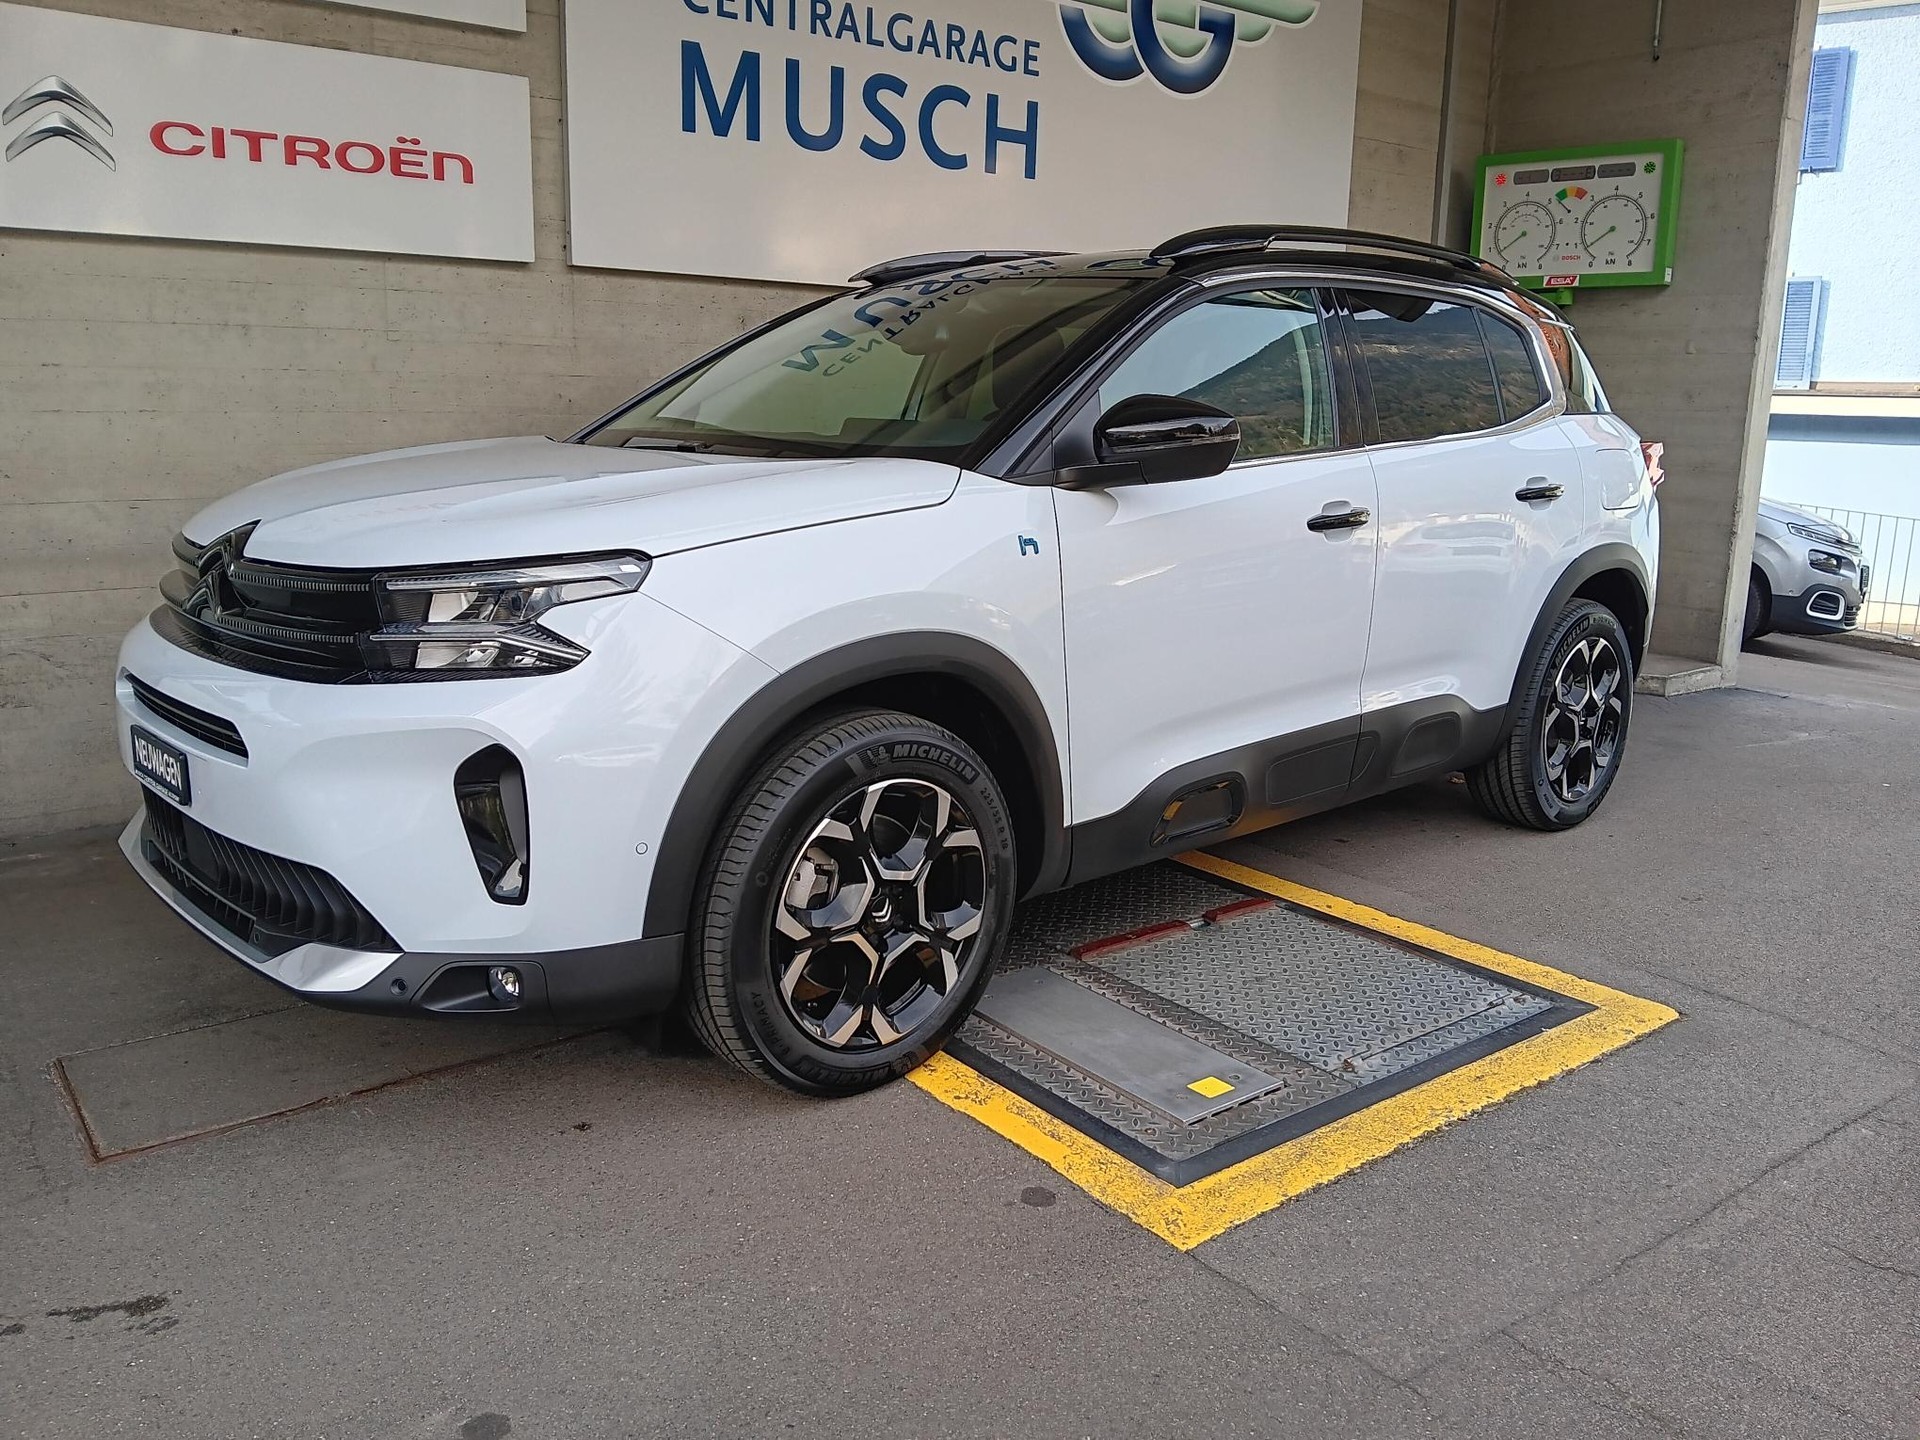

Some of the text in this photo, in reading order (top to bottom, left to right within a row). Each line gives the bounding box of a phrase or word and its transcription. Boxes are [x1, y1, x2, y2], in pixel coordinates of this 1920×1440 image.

[681, 40, 1039, 180] MUSCH
[149, 121, 474, 185] CITROËN
[1638, 191, 1643, 199] 5
[1627, 259, 1632, 267] 8
[1555, 617, 1589, 667] MICHELIN
[134, 735, 182, 791] NEUWAGEN
[892, 743, 976, 781] MICHELIN
